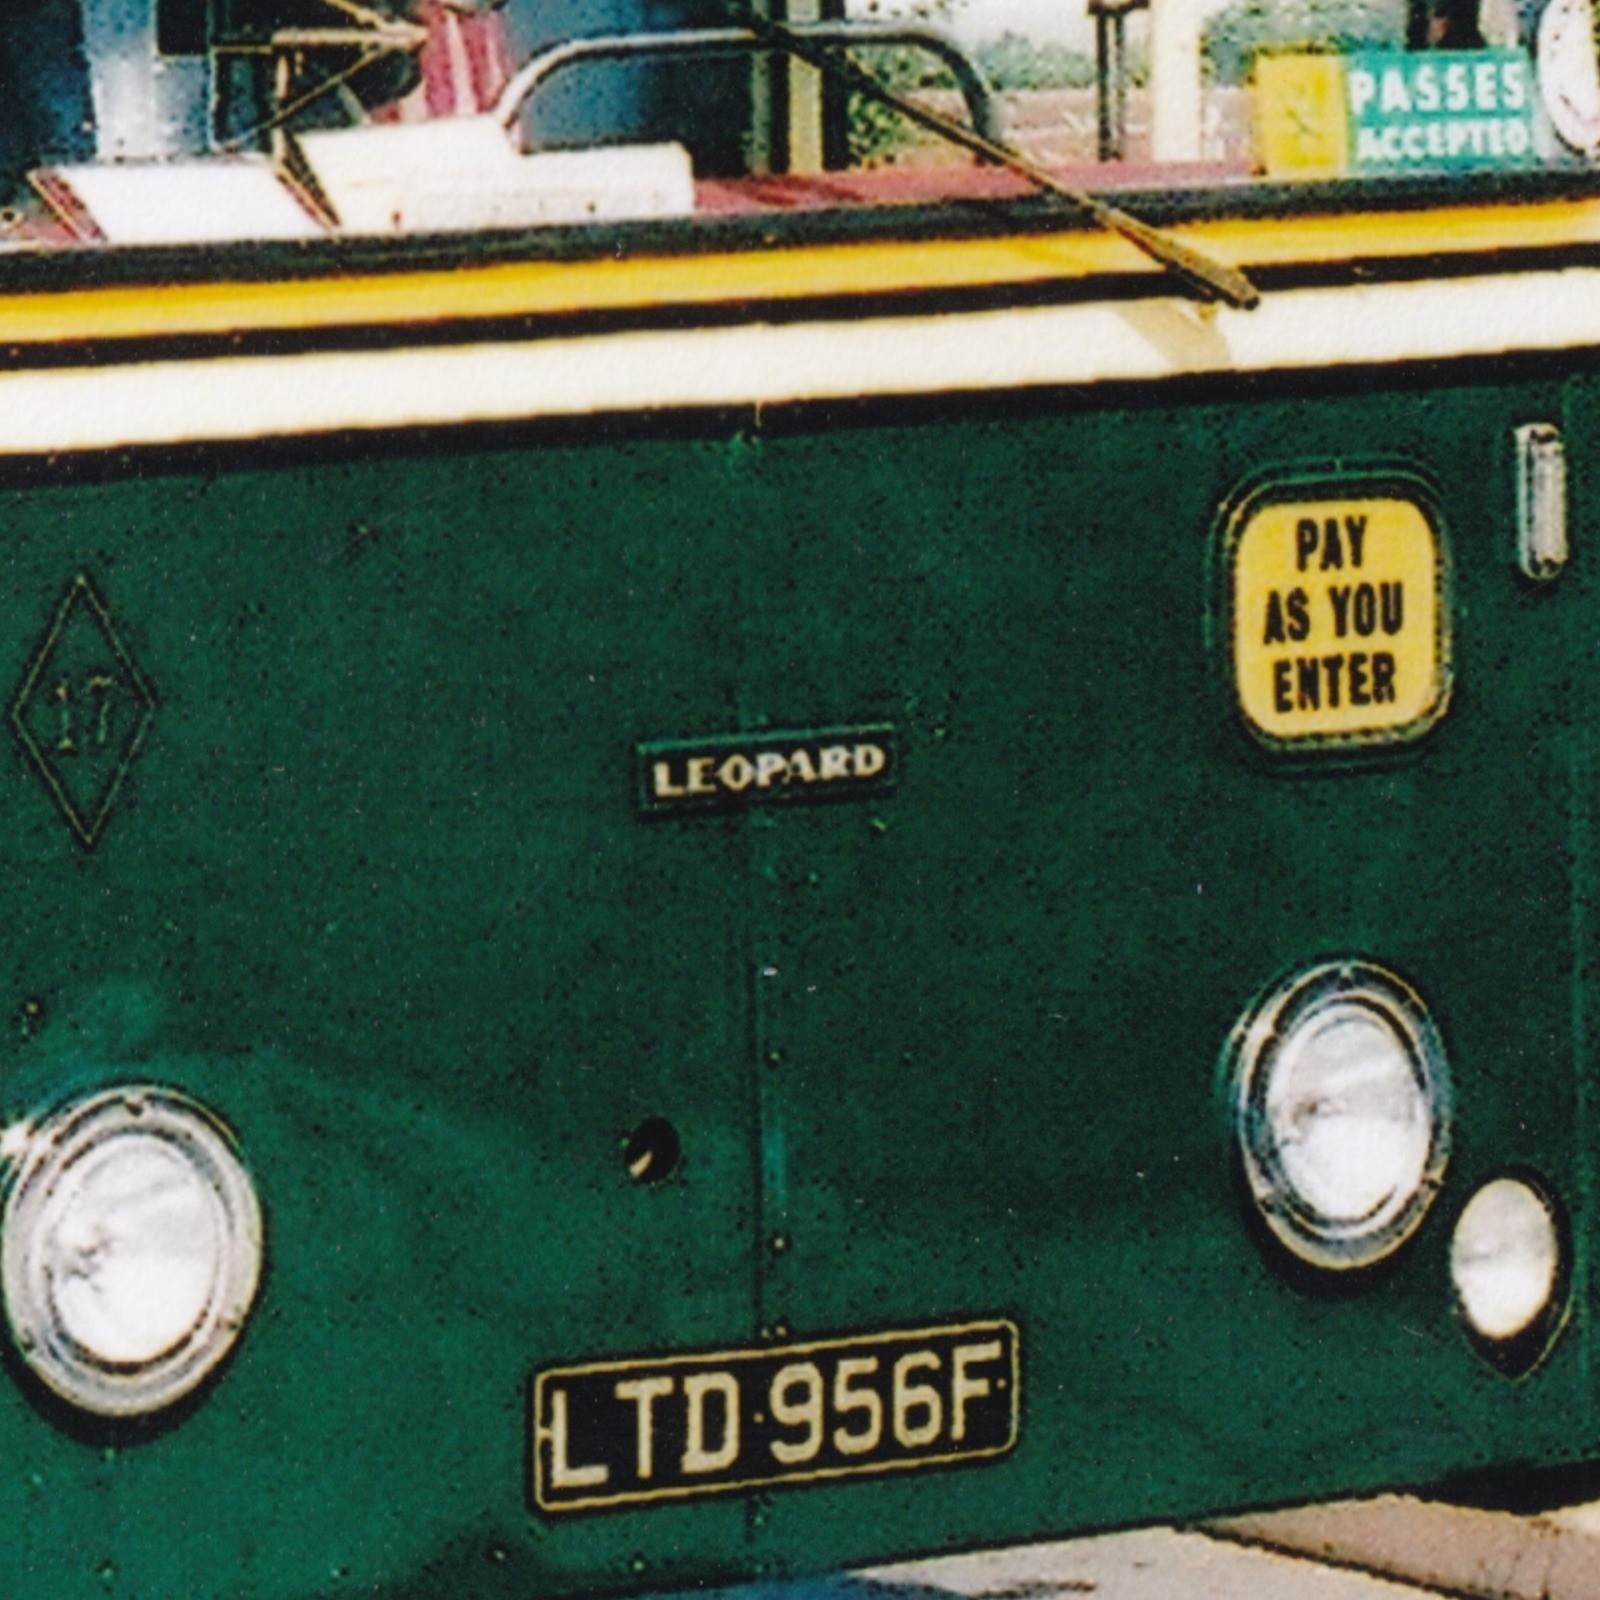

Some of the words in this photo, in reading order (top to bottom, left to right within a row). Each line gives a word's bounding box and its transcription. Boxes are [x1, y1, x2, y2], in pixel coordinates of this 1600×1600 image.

[1350, 62, 1525, 115] PASSES
[1357, 118, 1530, 159] ACCEPTED
[1296, 515, 1367, 572] PAY
[1263, 586, 1311, 645] AS
[1328, 581, 1404, 637] YOU
[1273, 652, 1396, 713] ENTER
[56, 675, 113, 750] 17
[653, 743, 886, 797] LEOPARD
[551, 1371, 740, 1488] LTD
[768, 1339, 1002, 1464] 956F
